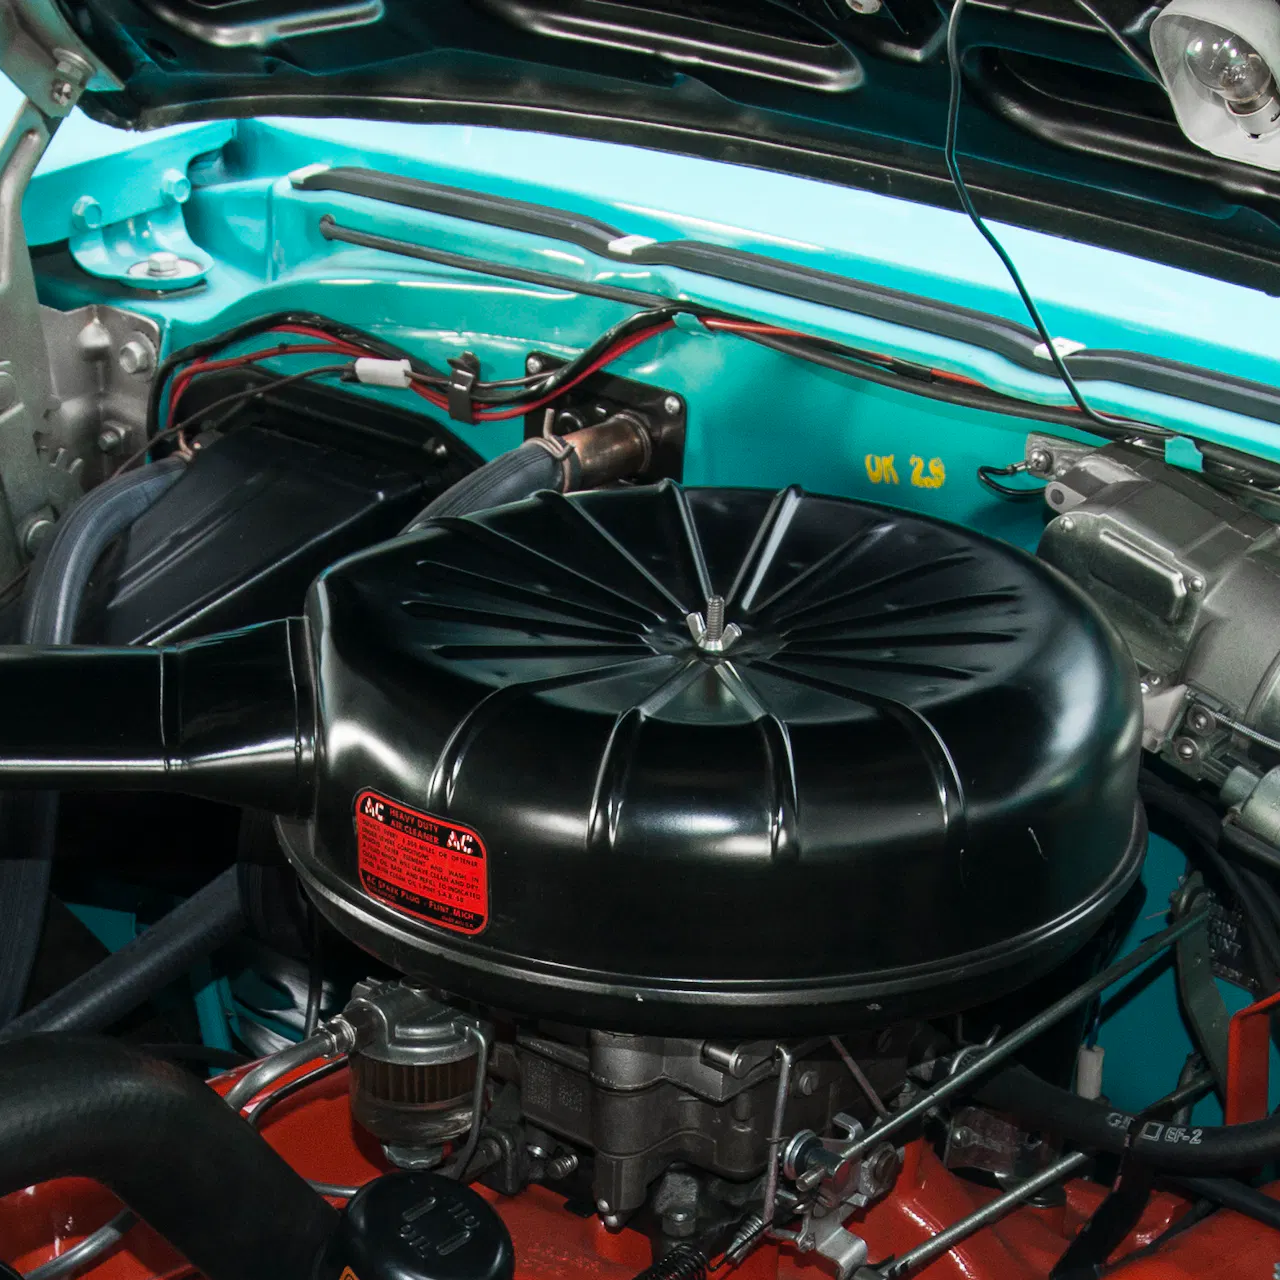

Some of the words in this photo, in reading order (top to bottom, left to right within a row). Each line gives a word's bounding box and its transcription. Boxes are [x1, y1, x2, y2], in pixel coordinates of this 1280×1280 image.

[365, 797, 384, 821] AC
[389, 808, 415, 824] HEAVY
[418, 818, 439, 833] DUTY
[390, 819, 403, 831] AIR
[404, 825, 439, 845] CLEANER
[446, 830, 473, 854] AC
[1164, 1126, 1204, 1145] EF-2
